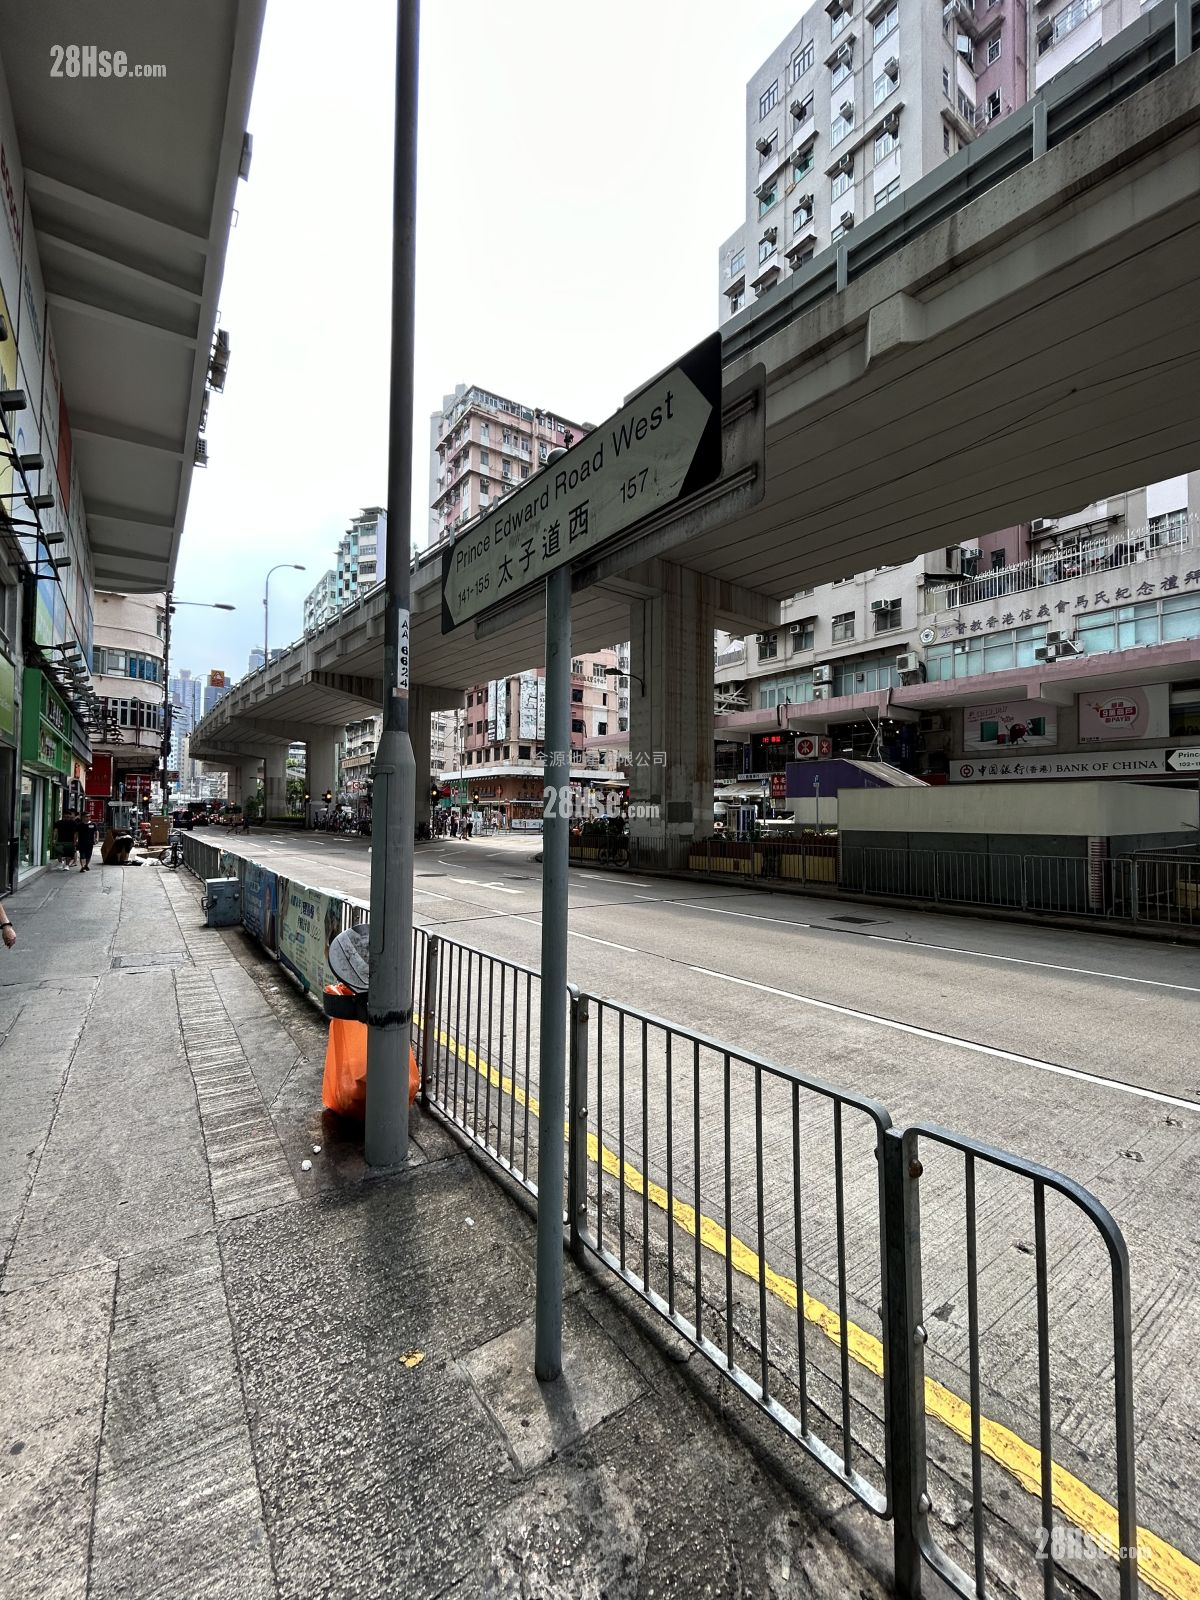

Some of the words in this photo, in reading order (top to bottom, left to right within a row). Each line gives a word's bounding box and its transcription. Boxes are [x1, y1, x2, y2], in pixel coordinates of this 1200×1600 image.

[455, 534, 490, 574] Prince
[494, 485, 549, 545] Edward
[555, 442, 604, 501] Road
[611, 389, 675, 456] West
[619, 468, 649, 504] 157
[498, 498, 590, 589] 太子道西
[457, 572, 490, 609] 141-155
[401, 619, 409, 640] AA
[1056, 763, 1089, 773] BANK
[1092, 762, 1109, 772] OF
[1112, 760, 1158, 771] CHINA
